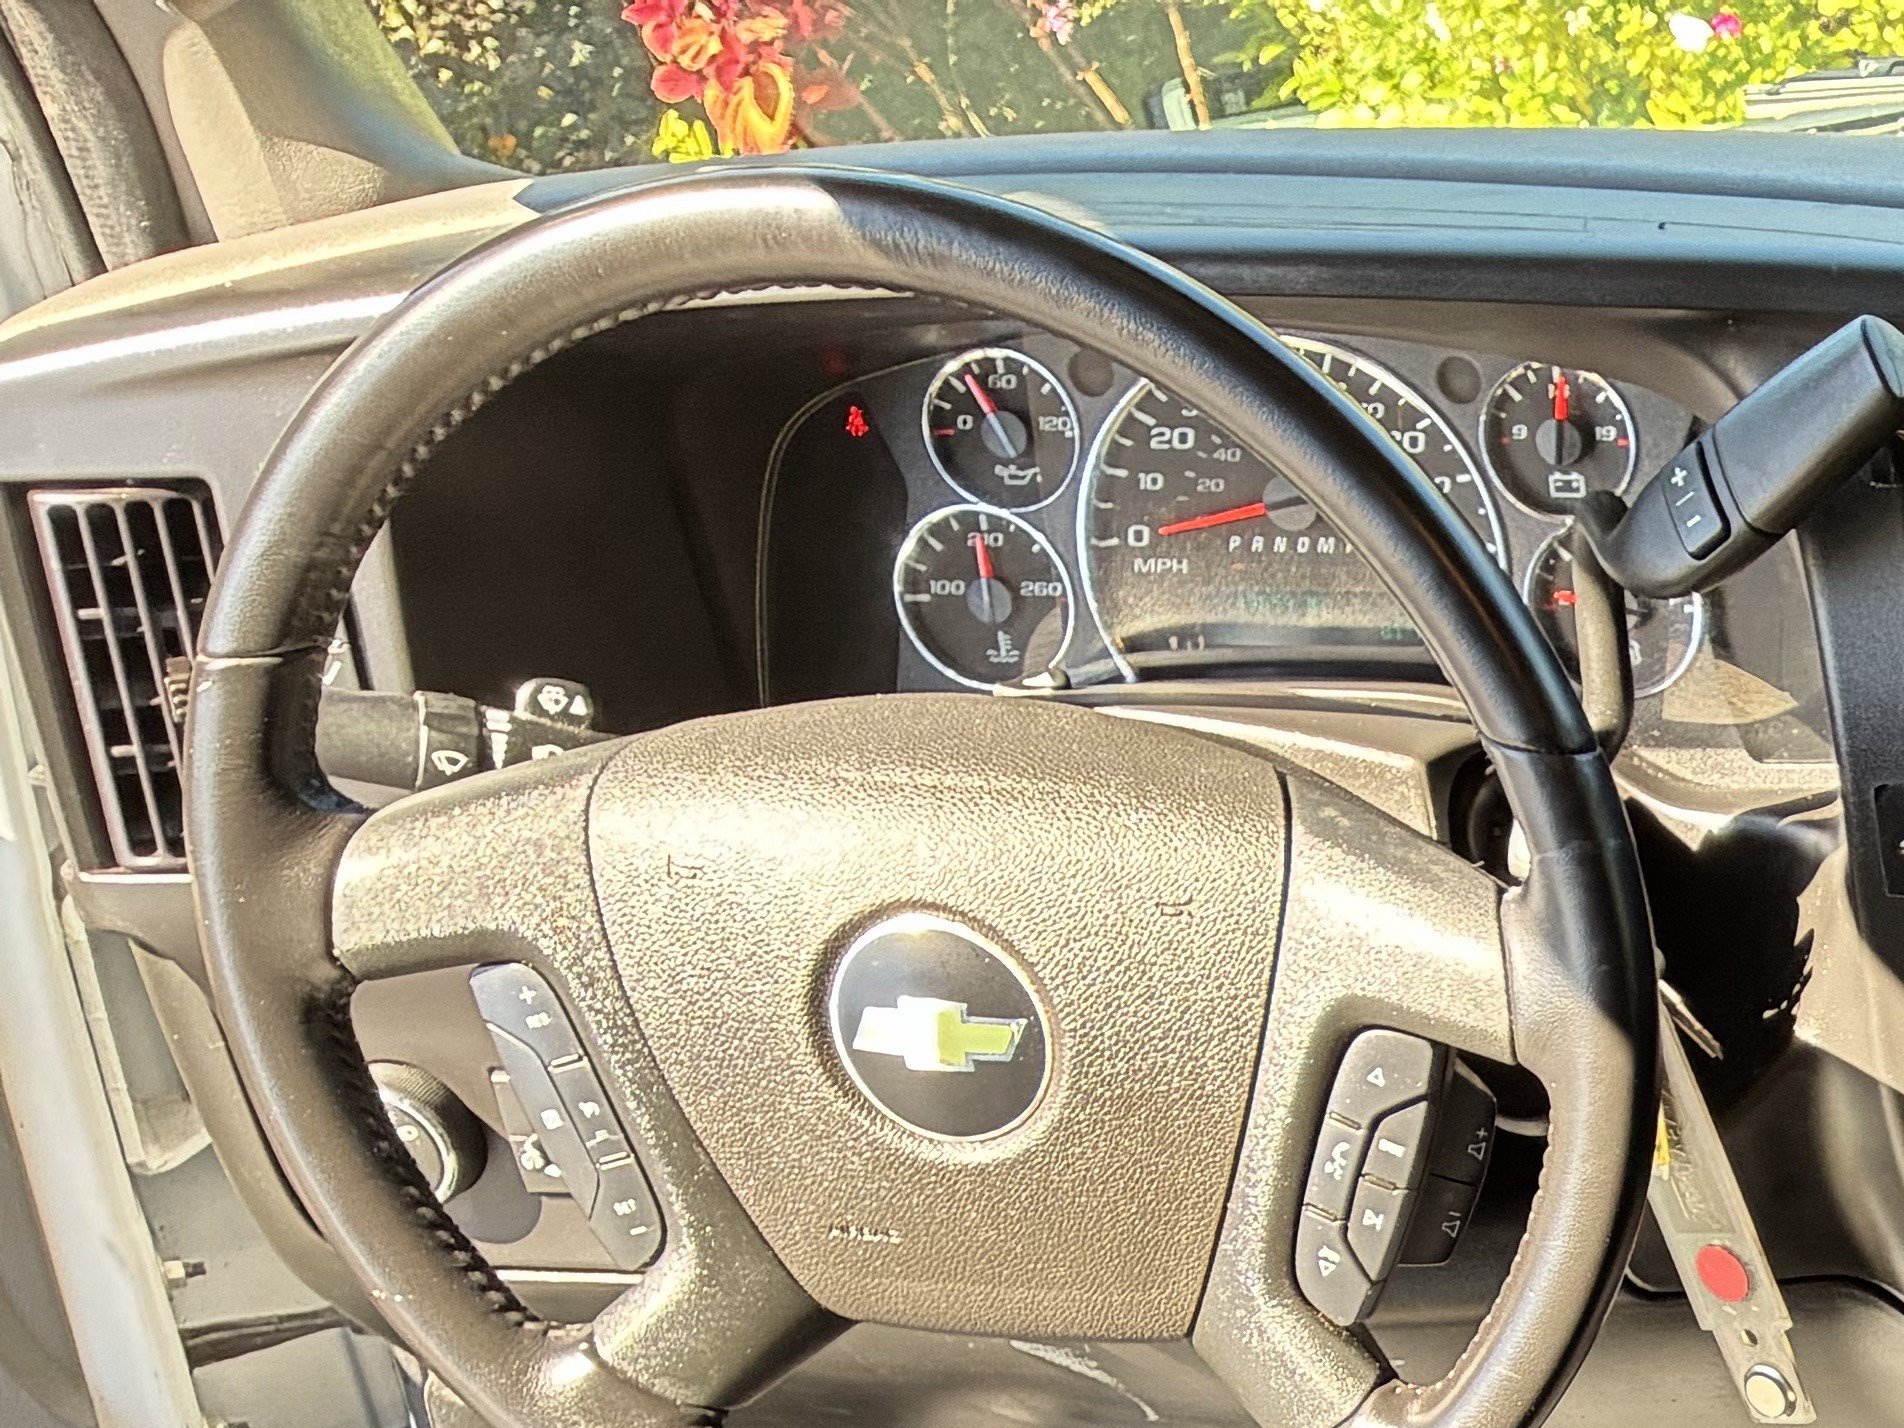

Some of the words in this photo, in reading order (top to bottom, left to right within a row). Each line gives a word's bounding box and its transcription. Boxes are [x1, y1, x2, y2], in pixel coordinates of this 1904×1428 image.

[988, 373, 1018, 390] 60
[957, 414, 974, 430] 0
[1038, 416, 1071, 431] 120
[1150, 427, 1196, 450] 20
[1511, 424, 1528, 440] 9
[1595, 425, 1617, 441] 19
[1212, 447, 1241, 462] 40
[1138, 472, 1165, 491] 10
[1196, 478, 1225, 493] 20
[1127, 524, 1150, 547] 0
[1133, 557, 1189, 574] MPH
[930, 579, 966, 595] 100
[1020, 580, 1063, 597] 260
